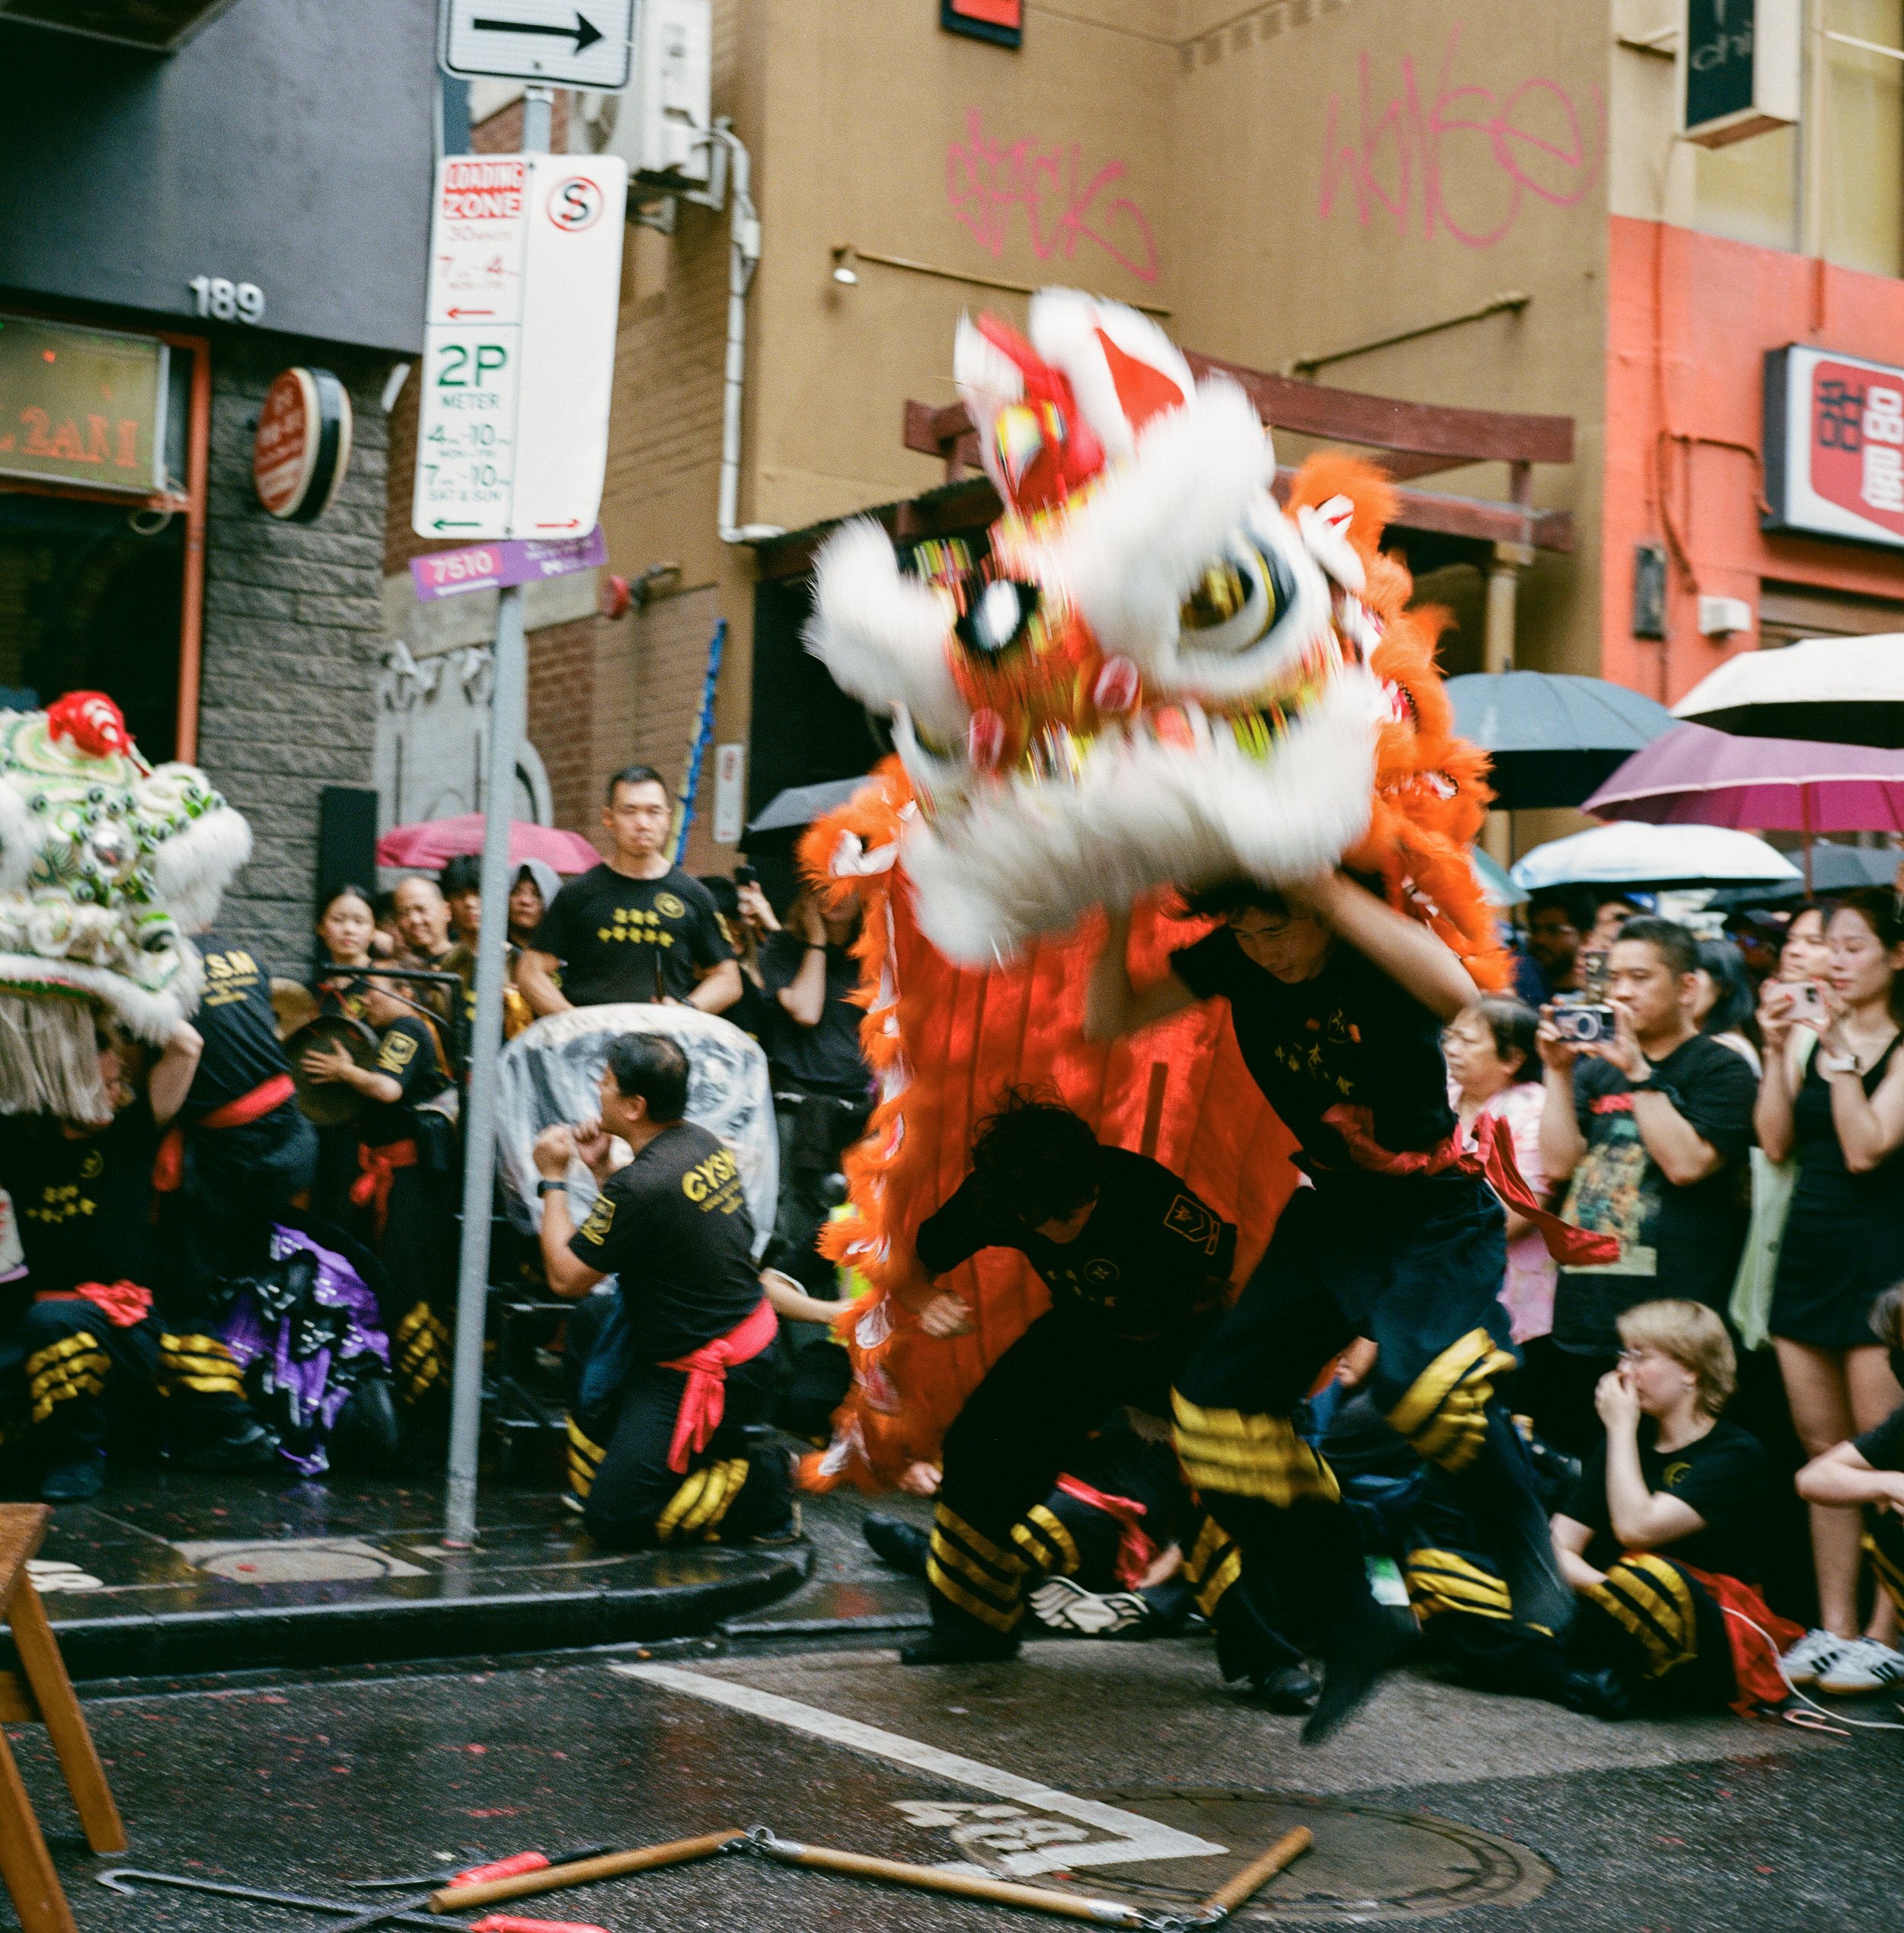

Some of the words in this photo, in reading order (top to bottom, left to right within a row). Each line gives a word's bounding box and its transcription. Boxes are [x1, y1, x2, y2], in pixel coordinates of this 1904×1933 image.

[443, 192, 523, 218] ZONE
[189, 275, 265, 324] 189
[437, 343, 509, 387] 2P
[439, 392, 500, 410] METER
